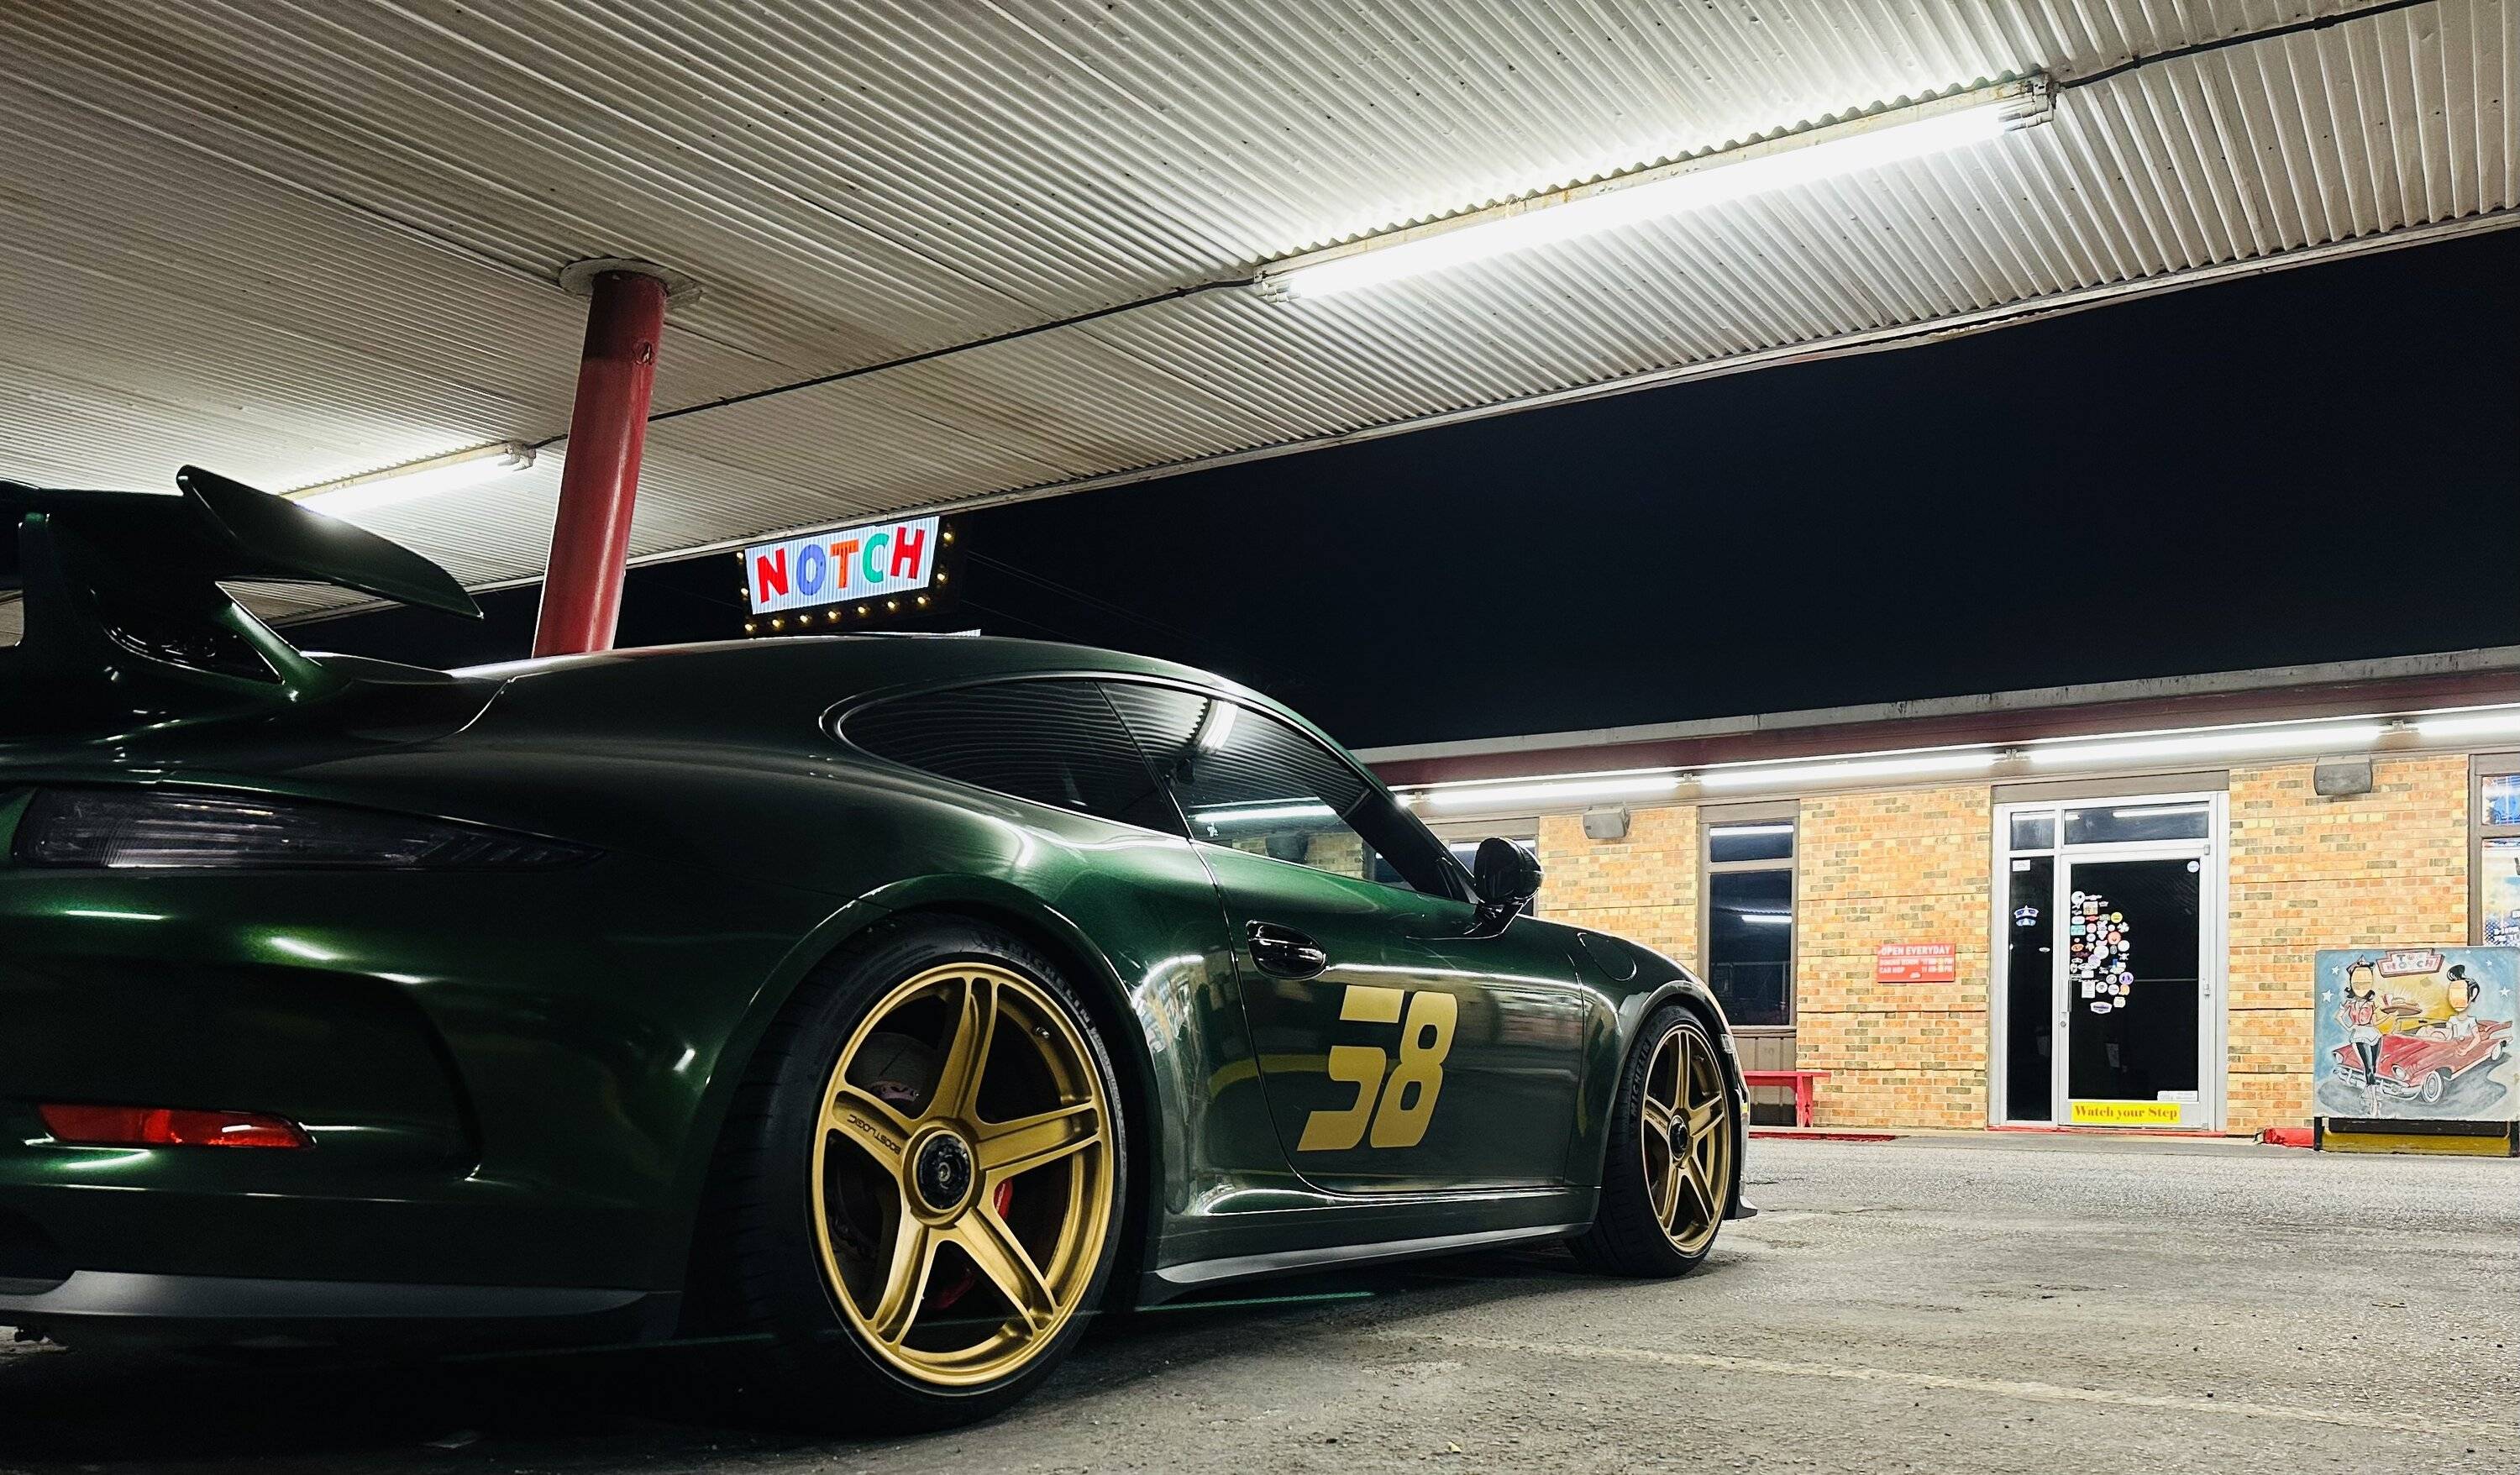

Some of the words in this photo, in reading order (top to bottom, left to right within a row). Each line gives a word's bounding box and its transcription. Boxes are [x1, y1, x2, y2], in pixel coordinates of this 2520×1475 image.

[757, 527, 926, 603] NOTCH
[1008, 942, 1090, 1023] MICHELIN
[1881, 945, 1904, 955] OPEN
[1906, 945, 1950, 955] EVERYDAY
[1297, 985, 1457, 1151] 58
[1630, 1039, 1652, 1117] MICHELIN
[2075, 1105, 2113, 1117] Watch
[2117, 1108, 2145, 1120] your
[2149, 1106, 2177, 1120] Step
